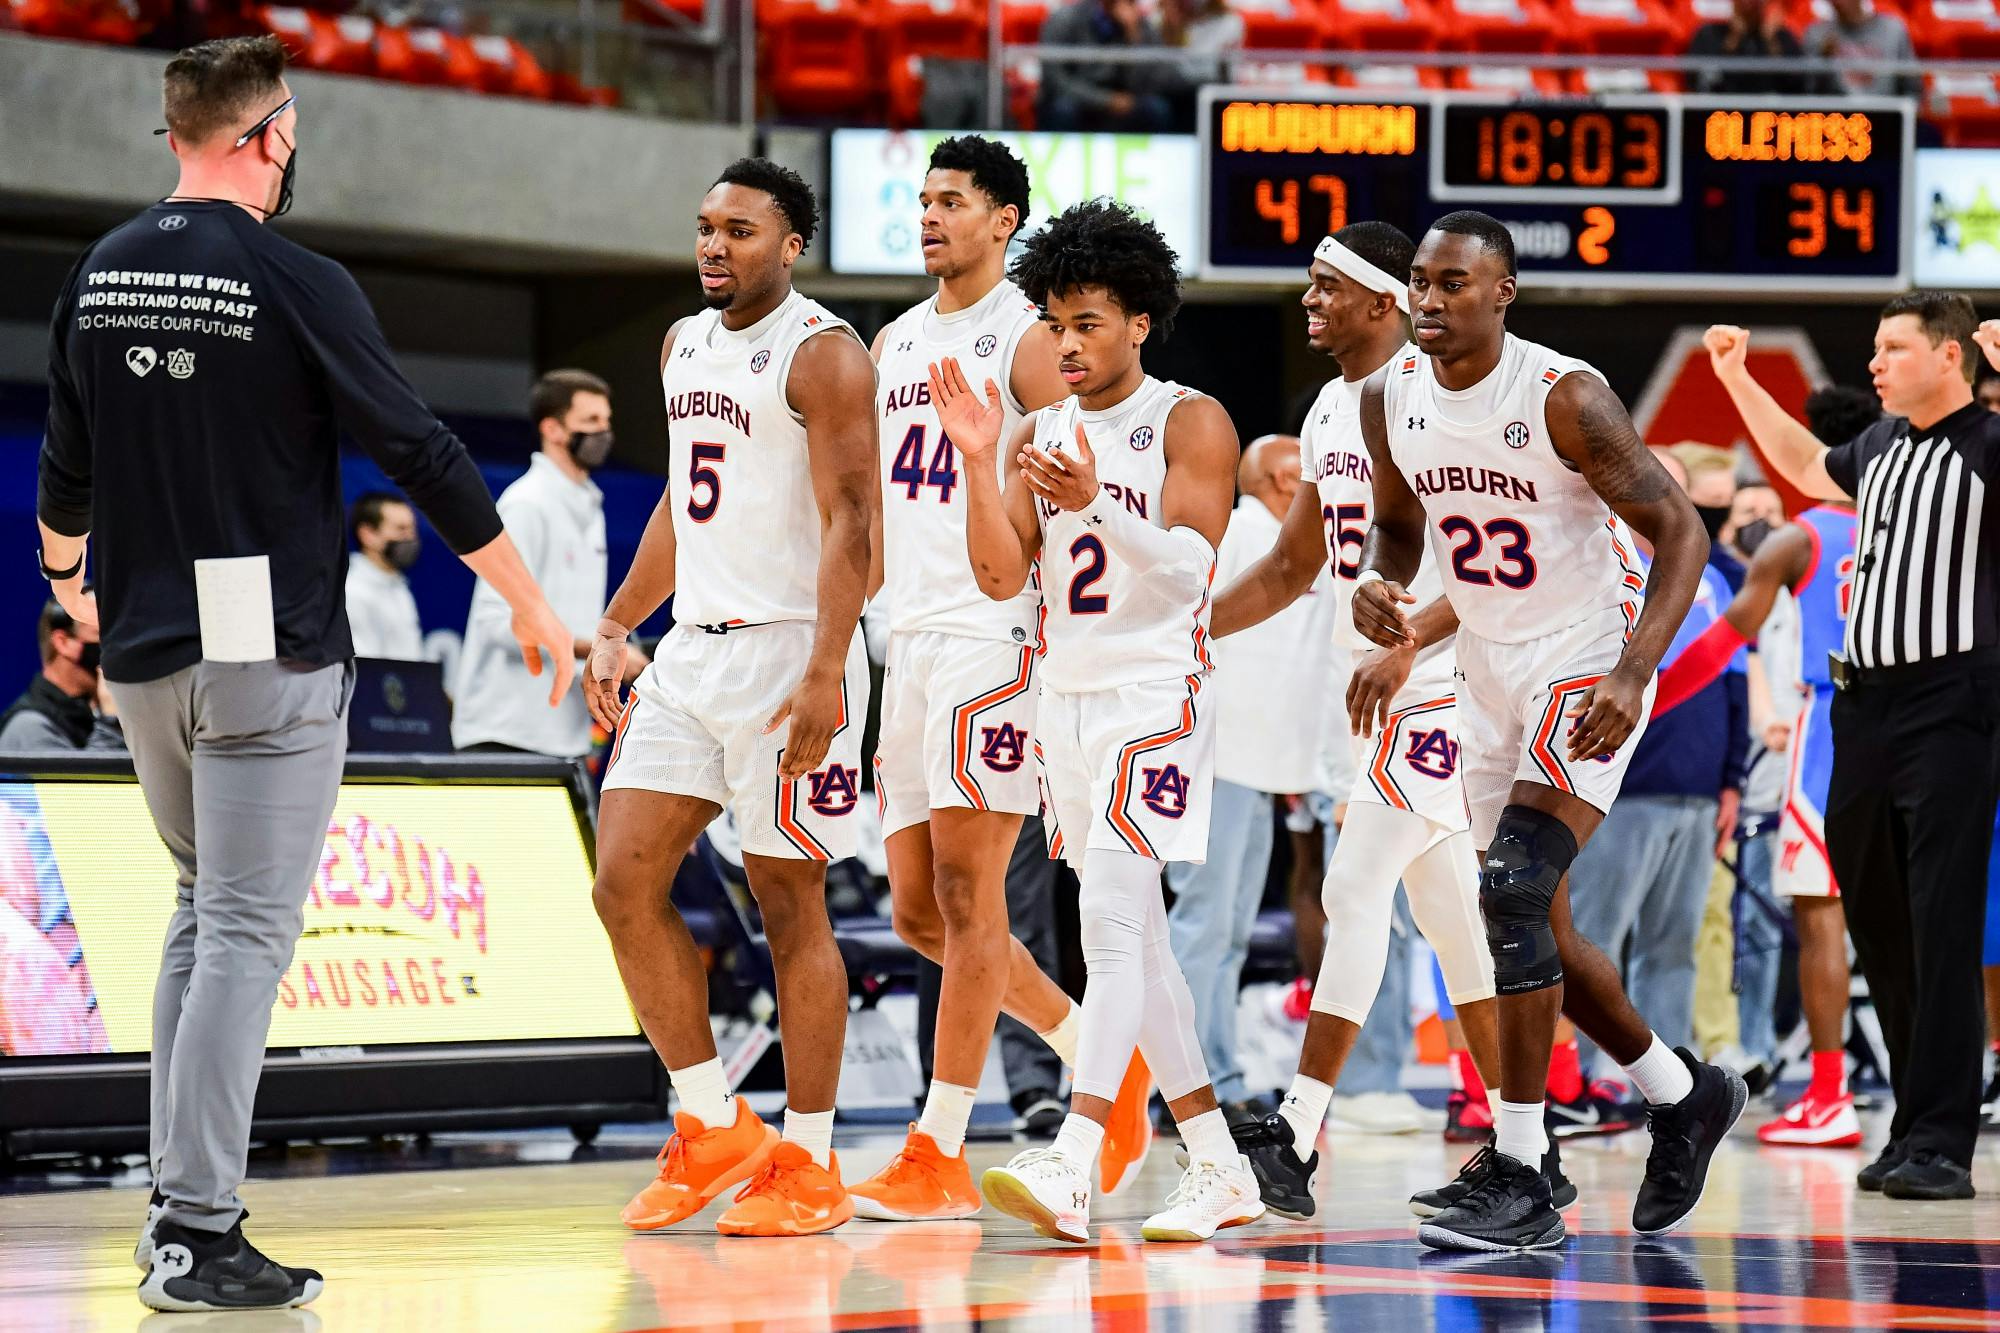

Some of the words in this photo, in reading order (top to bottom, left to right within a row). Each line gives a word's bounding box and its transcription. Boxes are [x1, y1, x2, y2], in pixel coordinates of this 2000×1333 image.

[1221, 102, 1416, 154] AUBURN
[1477, 110, 1662, 189] 18:03
[1255, 174, 1348, 245] 47
[1577, 206, 1616, 265] 2
[1786, 182, 1876, 258] 34
[79, 291, 178, 309] UNDERSTAND
[180, 295, 211, 312] OUR
[213, 300, 257, 320] PAST
[88, 271, 177, 287] TOGETHER
[179, 274, 204, 289] WE
[206, 276, 251, 297] WILL
[78, 315, 92, 331] TO
[93, 314, 159, 330] CHANGE
[161, 315, 191, 332] OUR
[193, 318, 254, 341] FUTURE
[668, 390, 751, 438] AUBURN
[1506, 423, 1528, 447] SEC
[687, 441, 726, 524] 5
[890, 423, 958, 504] 44
[1414, 466, 1539, 502] AUBURN
[1068, 532, 1110, 615] 2
[1438, 514, 1538, 590] 23
[280, 957, 456, 1009] SAUSAGE
